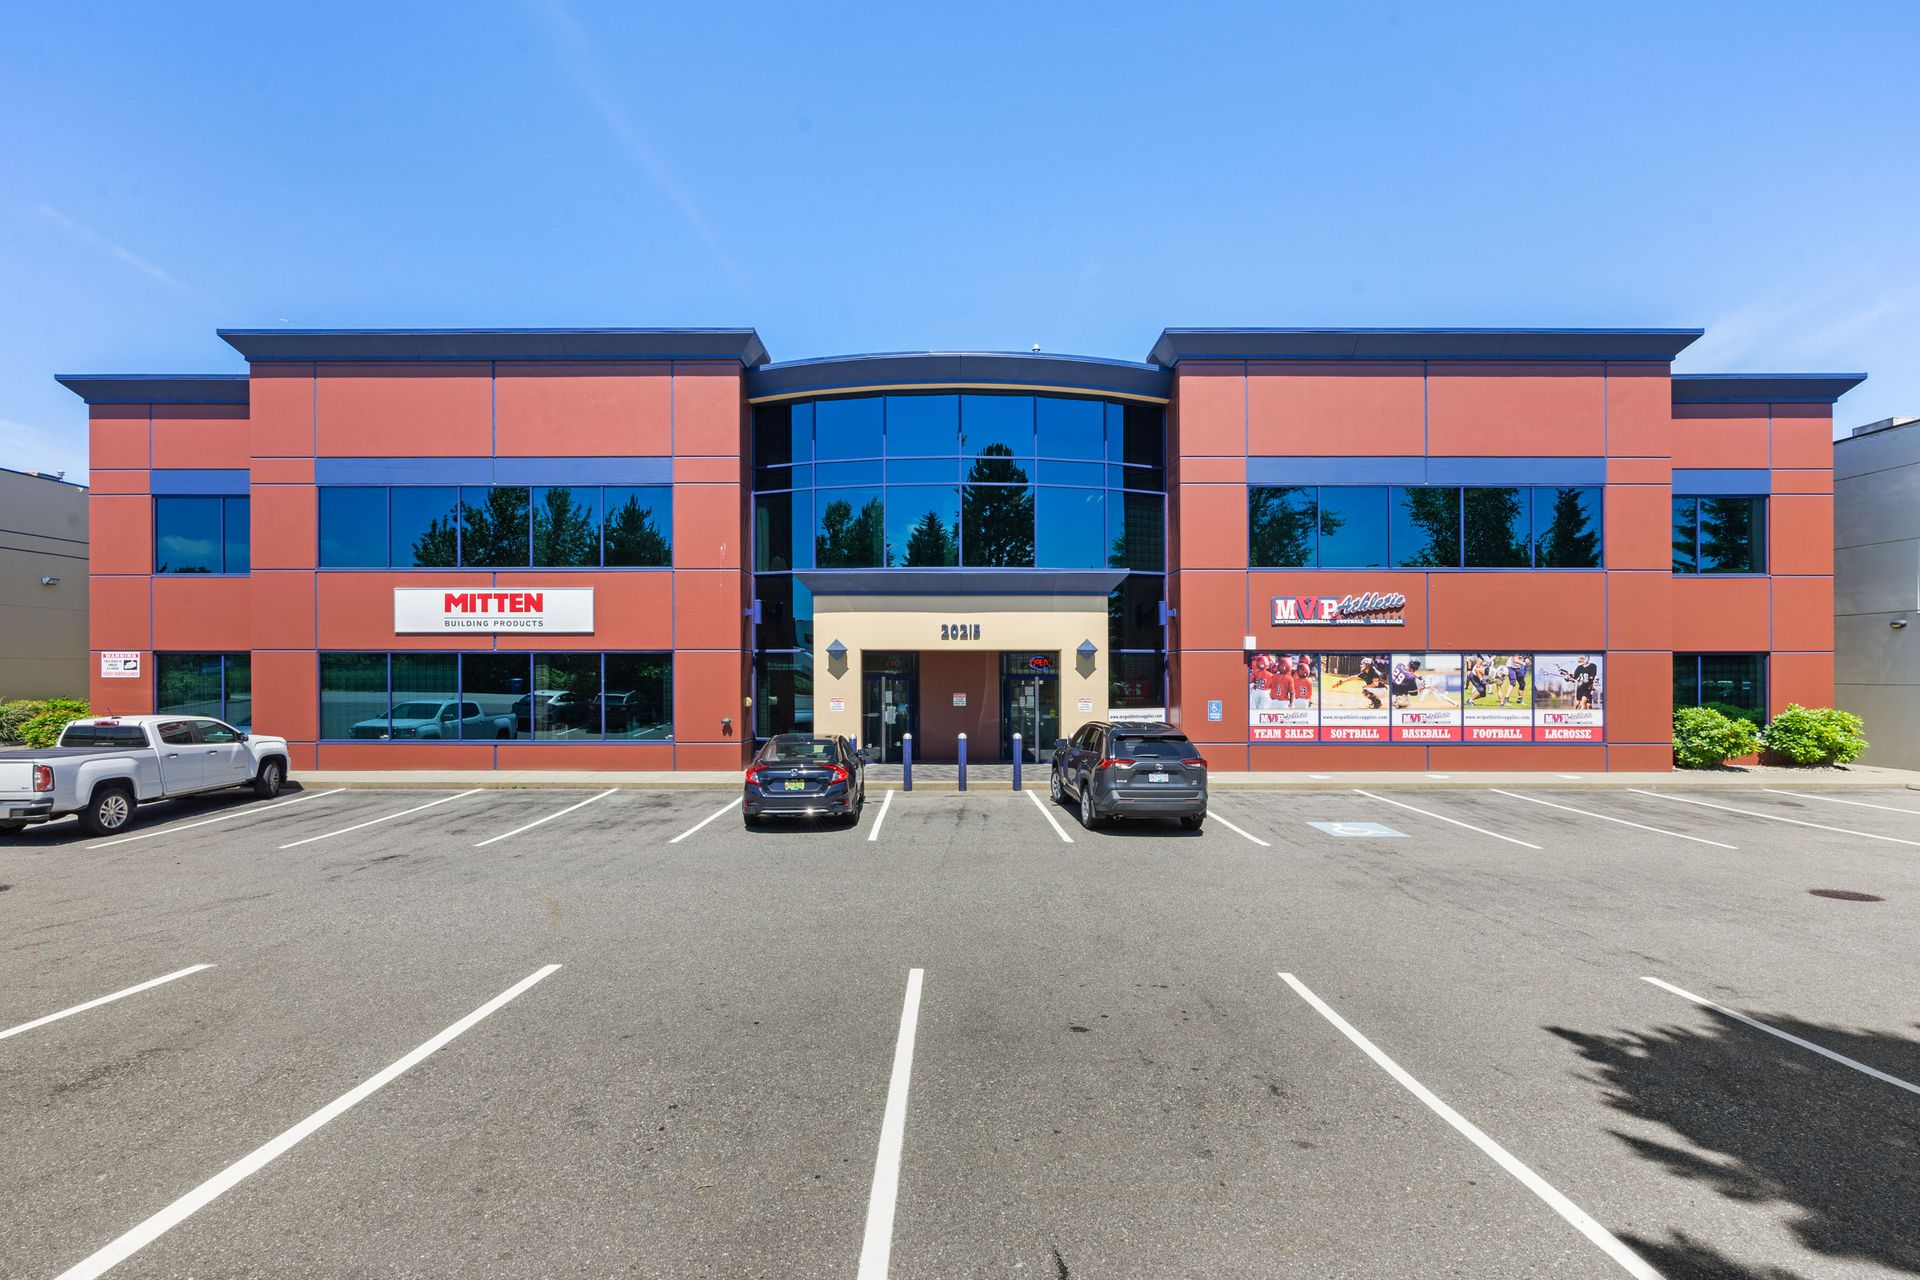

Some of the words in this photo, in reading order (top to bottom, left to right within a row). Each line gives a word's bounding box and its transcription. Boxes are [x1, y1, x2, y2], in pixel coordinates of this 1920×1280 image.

[444, 593, 543, 613] MITTEN
[1275, 597, 1338, 619] MVP
[1334, 592, 1406, 617] Athletic
[941, 623, 981, 641] 20215
[1030, 658, 1051, 667] OPEN
[1254, 729, 1282, 739] TEAM
[1284, 729, 1314, 739] SALES
[1330, 729, 1379, 739] SOFTBALL
[1402, 729, 1451, 739] BASEBALL
[1472, 729, 1522, 739] FOOTBALL
[1544, 729, 1592, 739] LACROSSE
